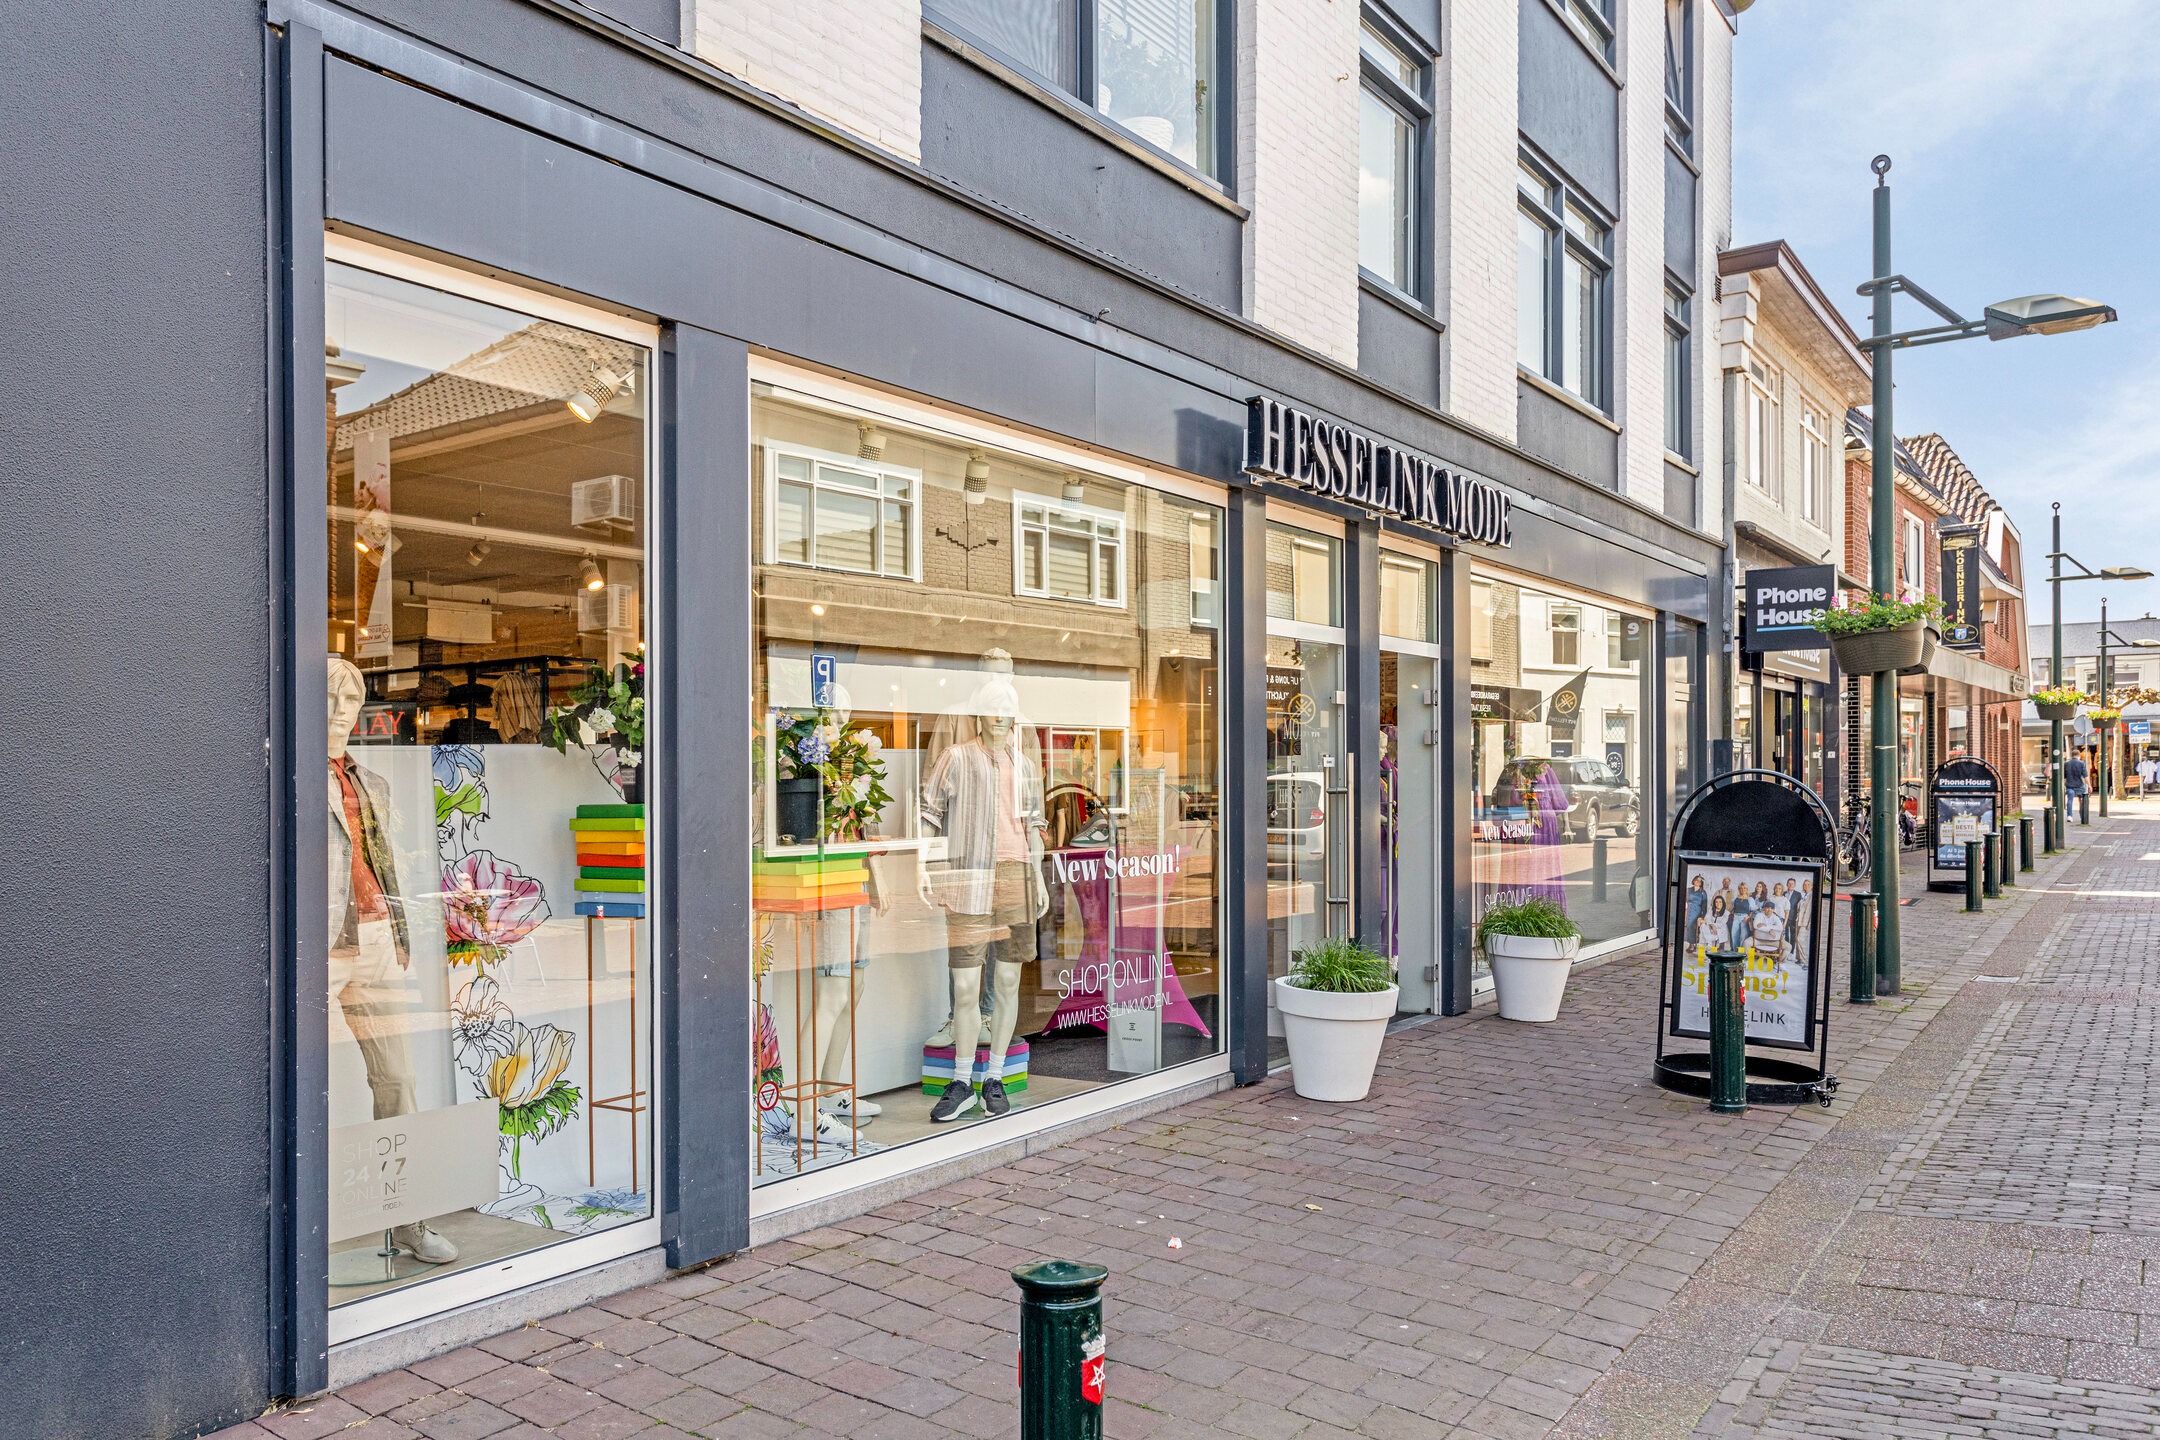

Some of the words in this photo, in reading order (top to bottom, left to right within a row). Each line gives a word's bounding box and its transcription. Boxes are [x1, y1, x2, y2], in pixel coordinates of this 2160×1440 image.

[1258, 395, 1440, 525] HESSELINK
[1444, 468, 1513, 549] MODE
[1756, 587, 1828, 606] Phone
[1955, 549, 1965, 624] KOENDERINK
[1756, 608, 1828, 626] House
[1965, 778, 1991, 786] House
[1481, 820, 1500, 842] New
[1051, 852, 1100, 885] New
[1103, 844, 1181, 881] Season!
